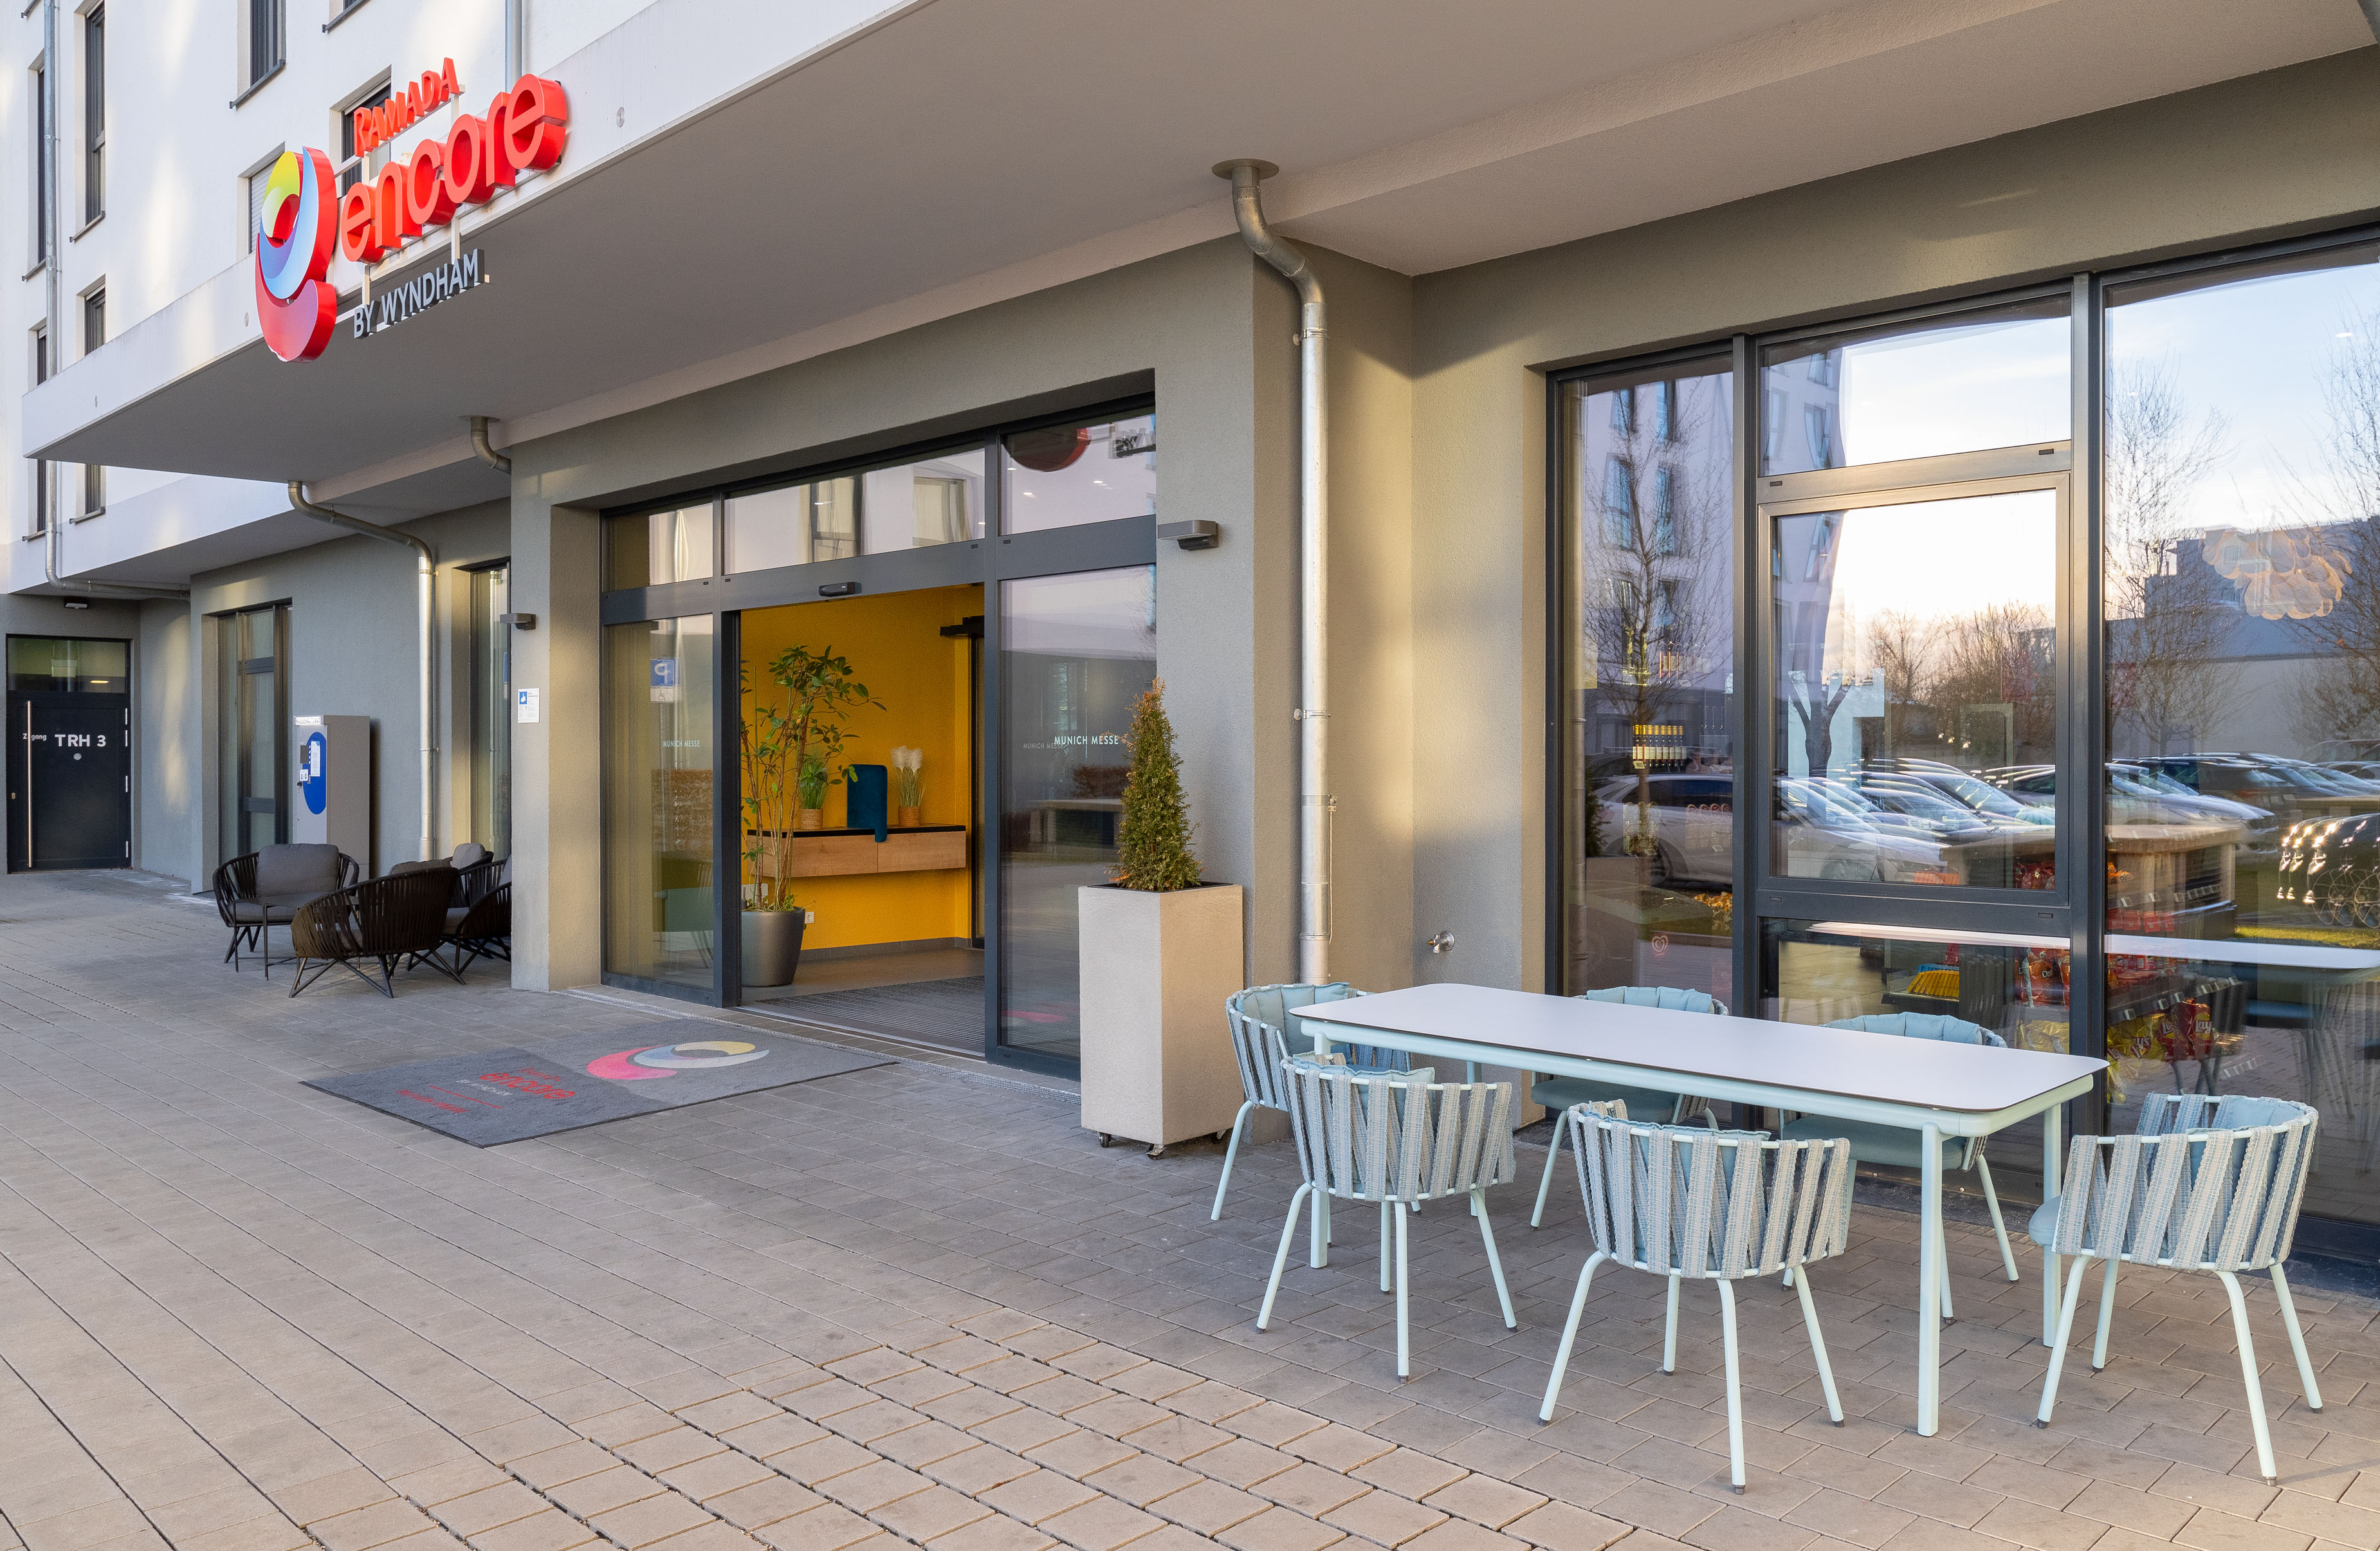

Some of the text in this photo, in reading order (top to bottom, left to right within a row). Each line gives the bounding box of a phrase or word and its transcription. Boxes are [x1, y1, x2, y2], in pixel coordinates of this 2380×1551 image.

[354, 57, 460, 157] RAMADA
[341, 73, 567, 264] encore
[354, 248, 484, 339] BY WYNDHAM
[55, 734, 106, 747] TRH 3
[1054, 735, 1119, 745] MUNICH MESSE
